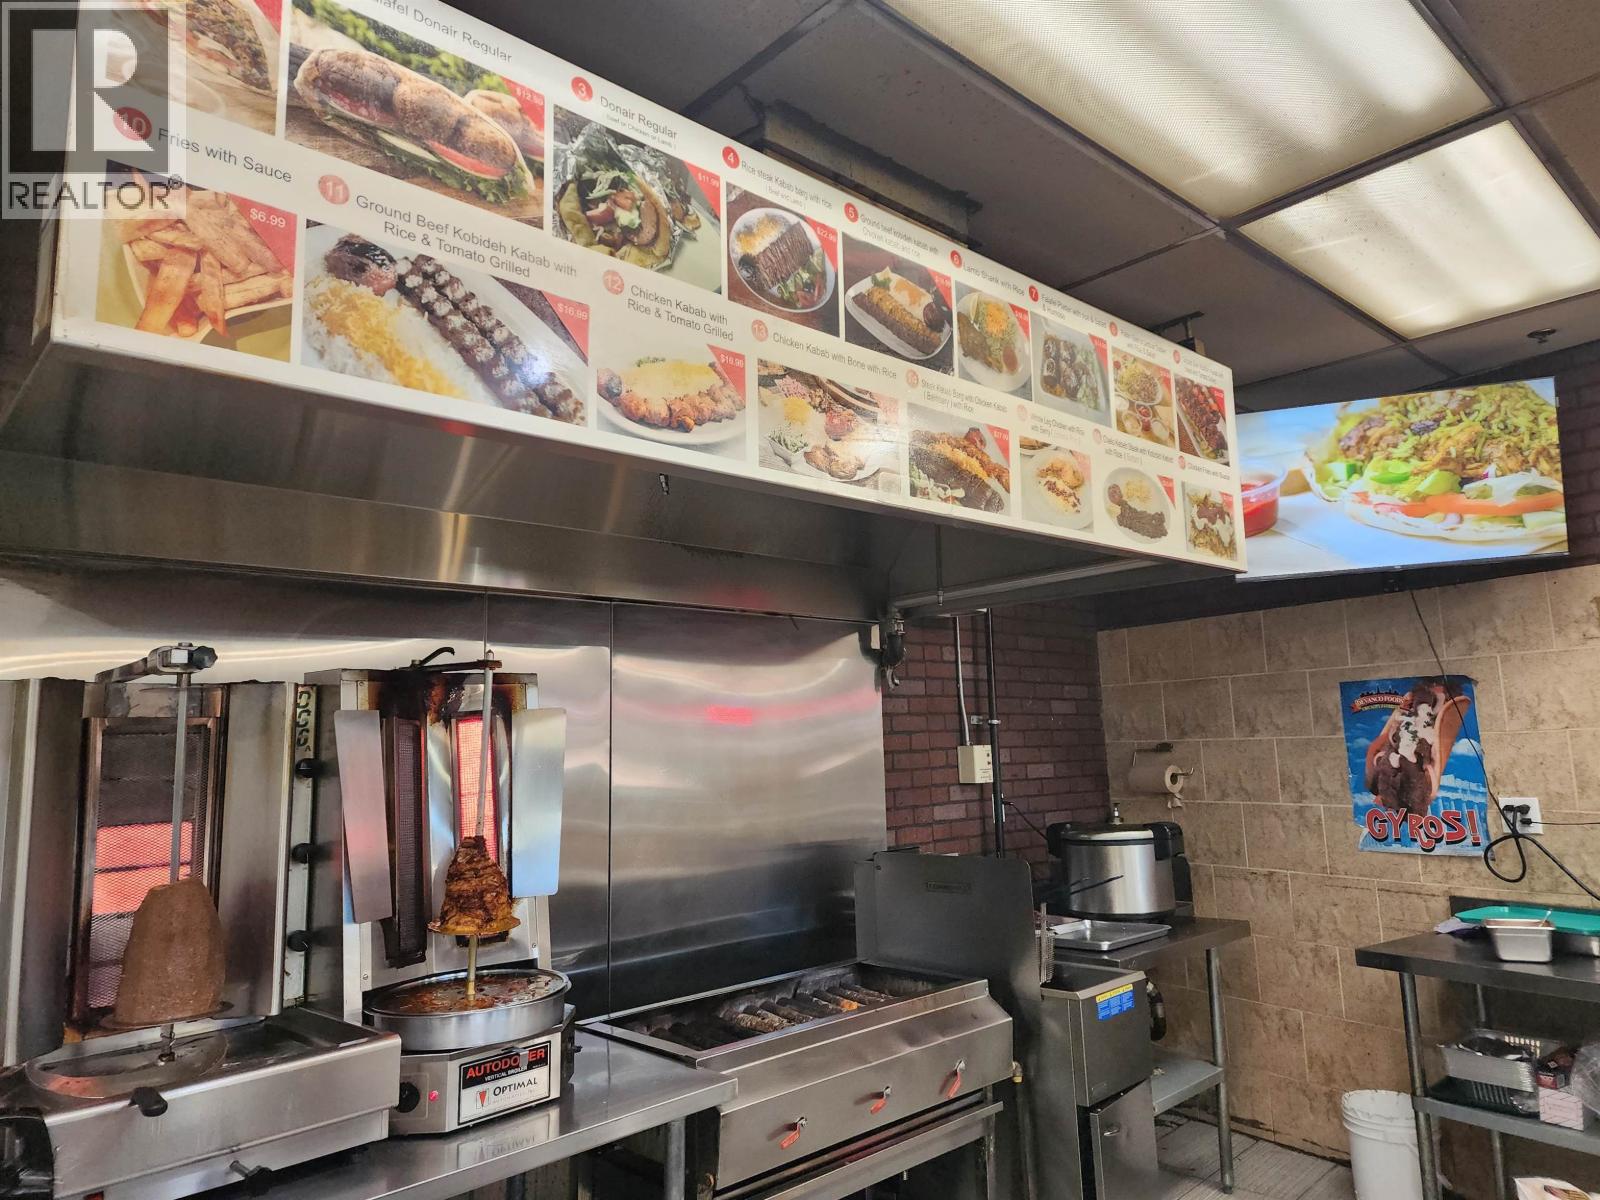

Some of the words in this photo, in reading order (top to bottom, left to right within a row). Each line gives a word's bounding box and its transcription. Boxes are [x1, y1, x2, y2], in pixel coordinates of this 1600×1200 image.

[377, 0, 409, 16] afel
[414, 8, 460, 40] Donair
[462, 31, 513, 63] Regular
[579, 82, 587, 95] 3
[600, 96, 636, 121] Donair
[638, 114, 679, 141] Regular
[158, 127, 201, 153] Fries
[205, 144, 238, 167] with
[242, 155, 293, 183] Sauce
[727, 152, 735, 163] 4
[325, 180, 346, 198] 11
[741, 160, 757, 177] Rice
[809, 192, 822, 204] with
[249, 207, 286, 229] $6.99
[847, 206, 855, 219] 5
[356, 194, 411, 223] Ground
[416, 208, 450, 234] Beef
[453, 219, 507, 255] Kobideh
[511, 239, 551, 268] Kabab
[553, 254, 578, 277] with
[383, 220, 417, 242] Rice
[421, 232, 432, 247] &
[436, 236, 485, 264] Tomato
[490, 253, 530, 279] Grilled
[605, 272, 622, 291] 12
[627, 297, 651, 317] Rice
[654, 308, 662, 319] &
[665, 309, 701, 331] Tomato
[703, 322, 735, 342] Grilled
[629, 284, 673, 309] Chicken
[675, 300, 707, 319] Kabab
[708, 309, 728, 326] with
[772, 332, 804, 352] Chicken
[806, 342, 830, 360] Kabab
[831, 352, 847, 366] with
[847, 355, 866, 371] Bone
[866, 363, 882, 376] with
[882, 367, 897, 380] Rice
[1365, 807, 1482, 850] GYROS!
[466, 1048, 546, 1079] AUTODOER
[484, 1072, 507, 1083] VERTICAL
[493, 1077, 538, 1097] OPTIMAL
